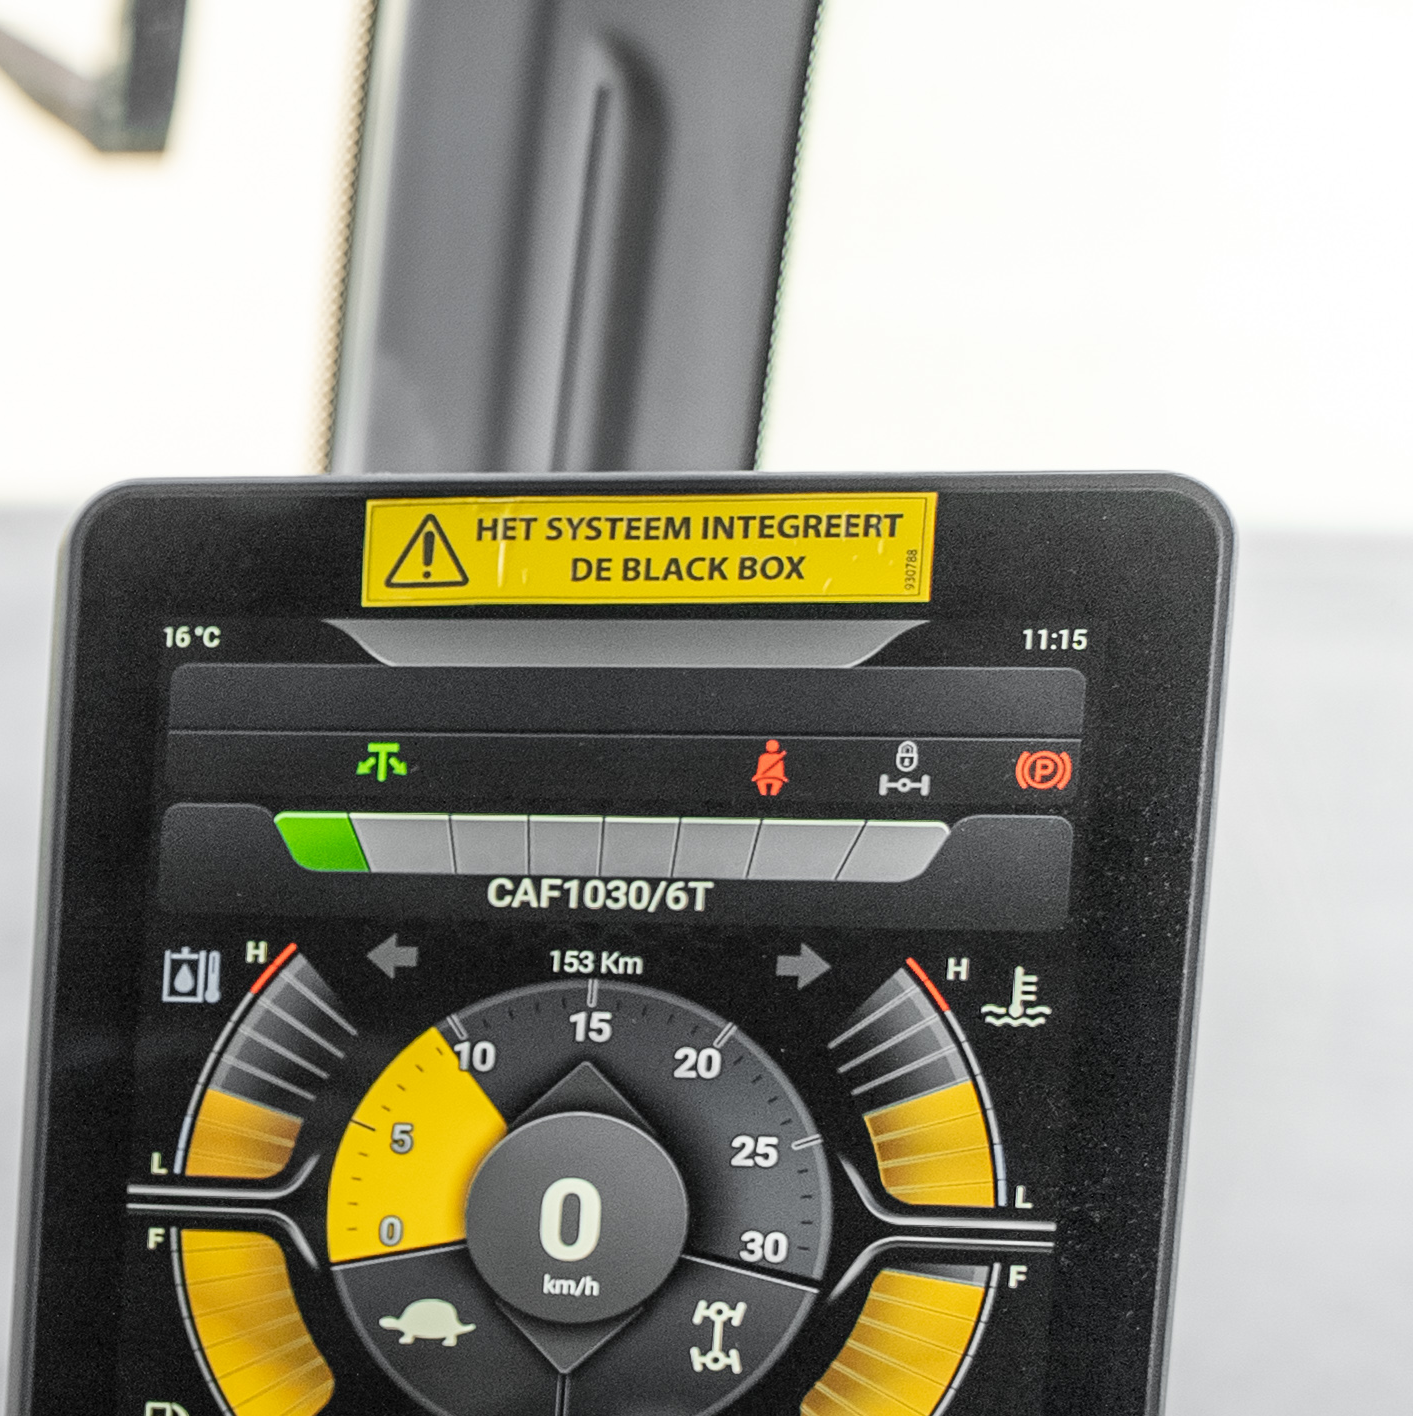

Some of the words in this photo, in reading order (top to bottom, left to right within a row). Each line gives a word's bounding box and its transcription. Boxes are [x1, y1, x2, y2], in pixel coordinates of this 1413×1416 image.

[476, 517, 539, 542] HET
[545, 516, 691, 541] SYSTEEM
[701, 513, 904, 540] INTEGREERT
[571, 557, 613, 582] DE
[622, 556, 729, 582] BLACK
[737, 555, 806, 581] BOX
[904, 549, 918, 591] 930788
[1022, 628, 1088, 651] 11:15
[487, 878, 714, 912] CAF1030/6T
[245, 940, 268, 964] H
[550, 951, 595, 974] 153
[600, 951, 643, 975] Km
[946, 957, 969, 981] H
[569, 1011, 612, 1043] 15
[454, 1041, 496, 1073] 10
[673, 1046, 722, 1079] 20
[389, 1124, 414, 1154] 5
[731, 1135, 779, 1168] 25
[150, 1151, 168, 1175] L
[1014, 1185, 1033, 1209] L
[379, 1214, 405, 1248] 0
[539, 1177, 602, 1262] 0
[147, 1227, 165, 1250] F
[739, 1230, 789, 1263] 30
[543, 1273, 600, 1297] km/h
[1008, 1264, 1028, 1289] F
